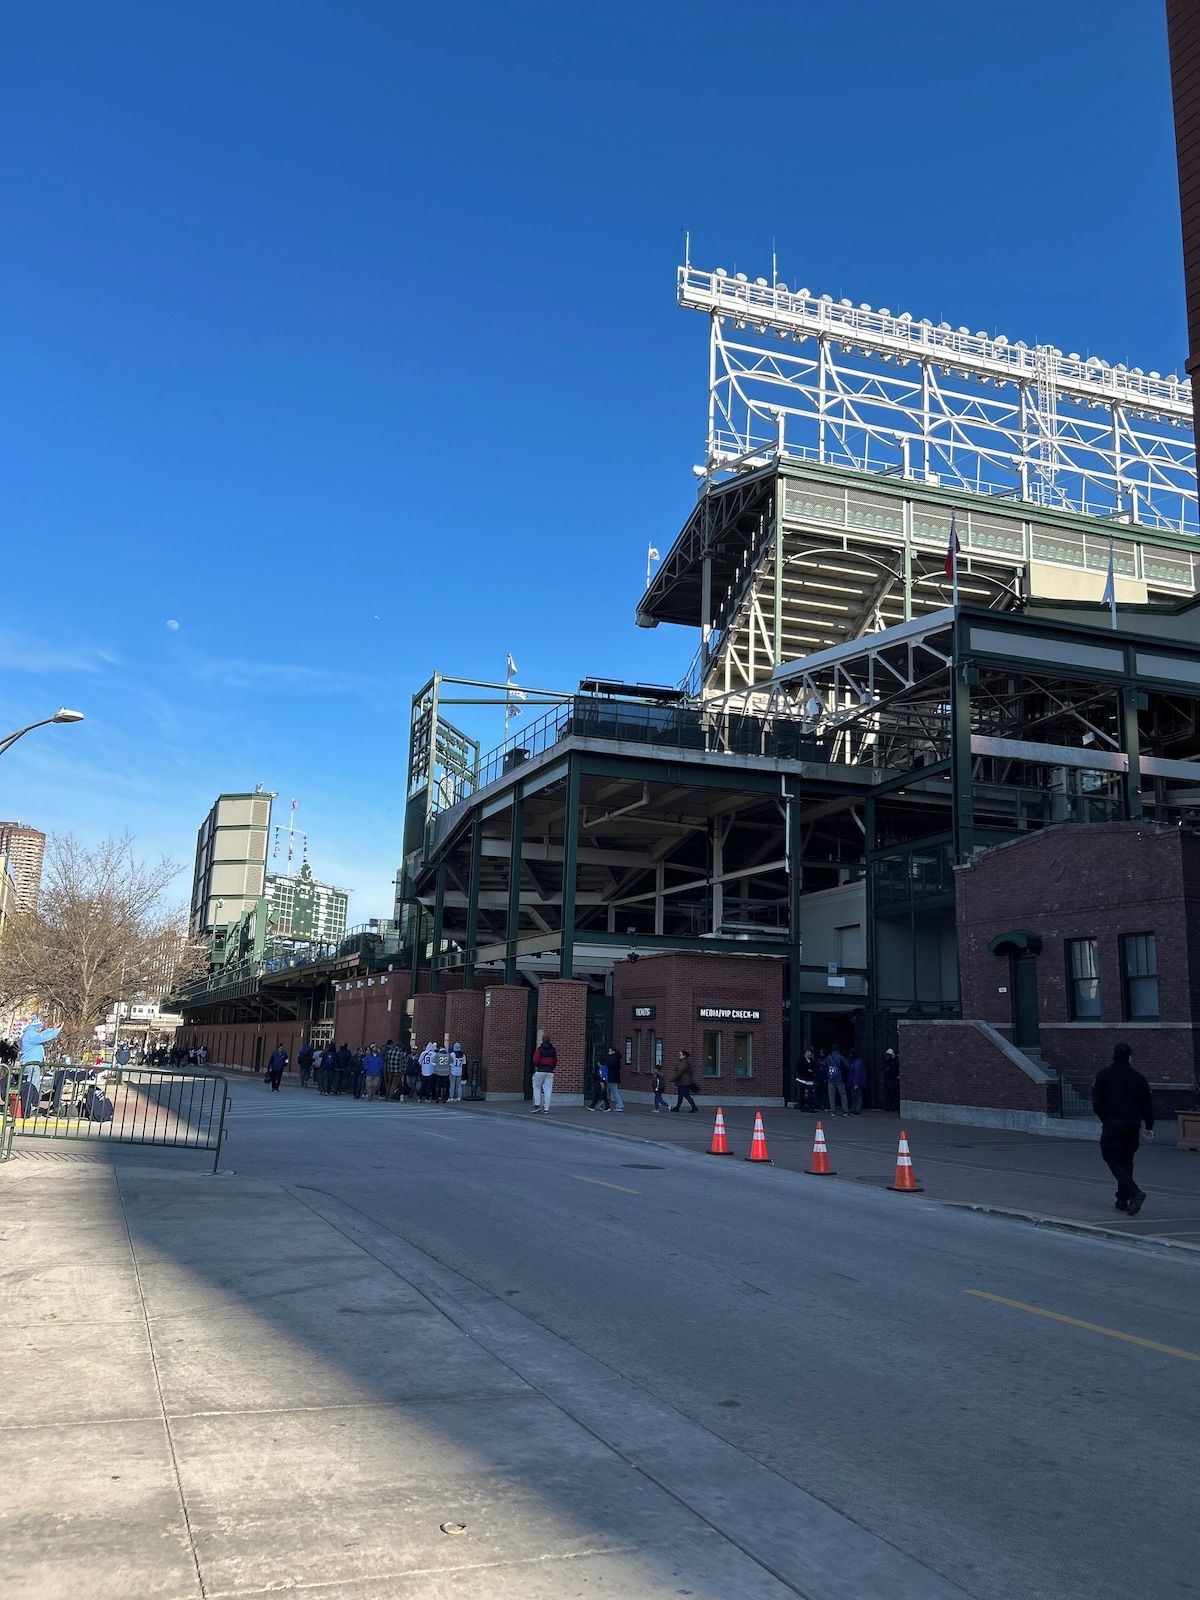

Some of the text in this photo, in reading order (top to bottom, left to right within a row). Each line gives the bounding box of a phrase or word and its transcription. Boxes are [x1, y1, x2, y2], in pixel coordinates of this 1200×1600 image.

[700, 1009, 760, 1019] MEDIA/VIP CHECK-IN
[423, 1057, 431, 1065] 18
